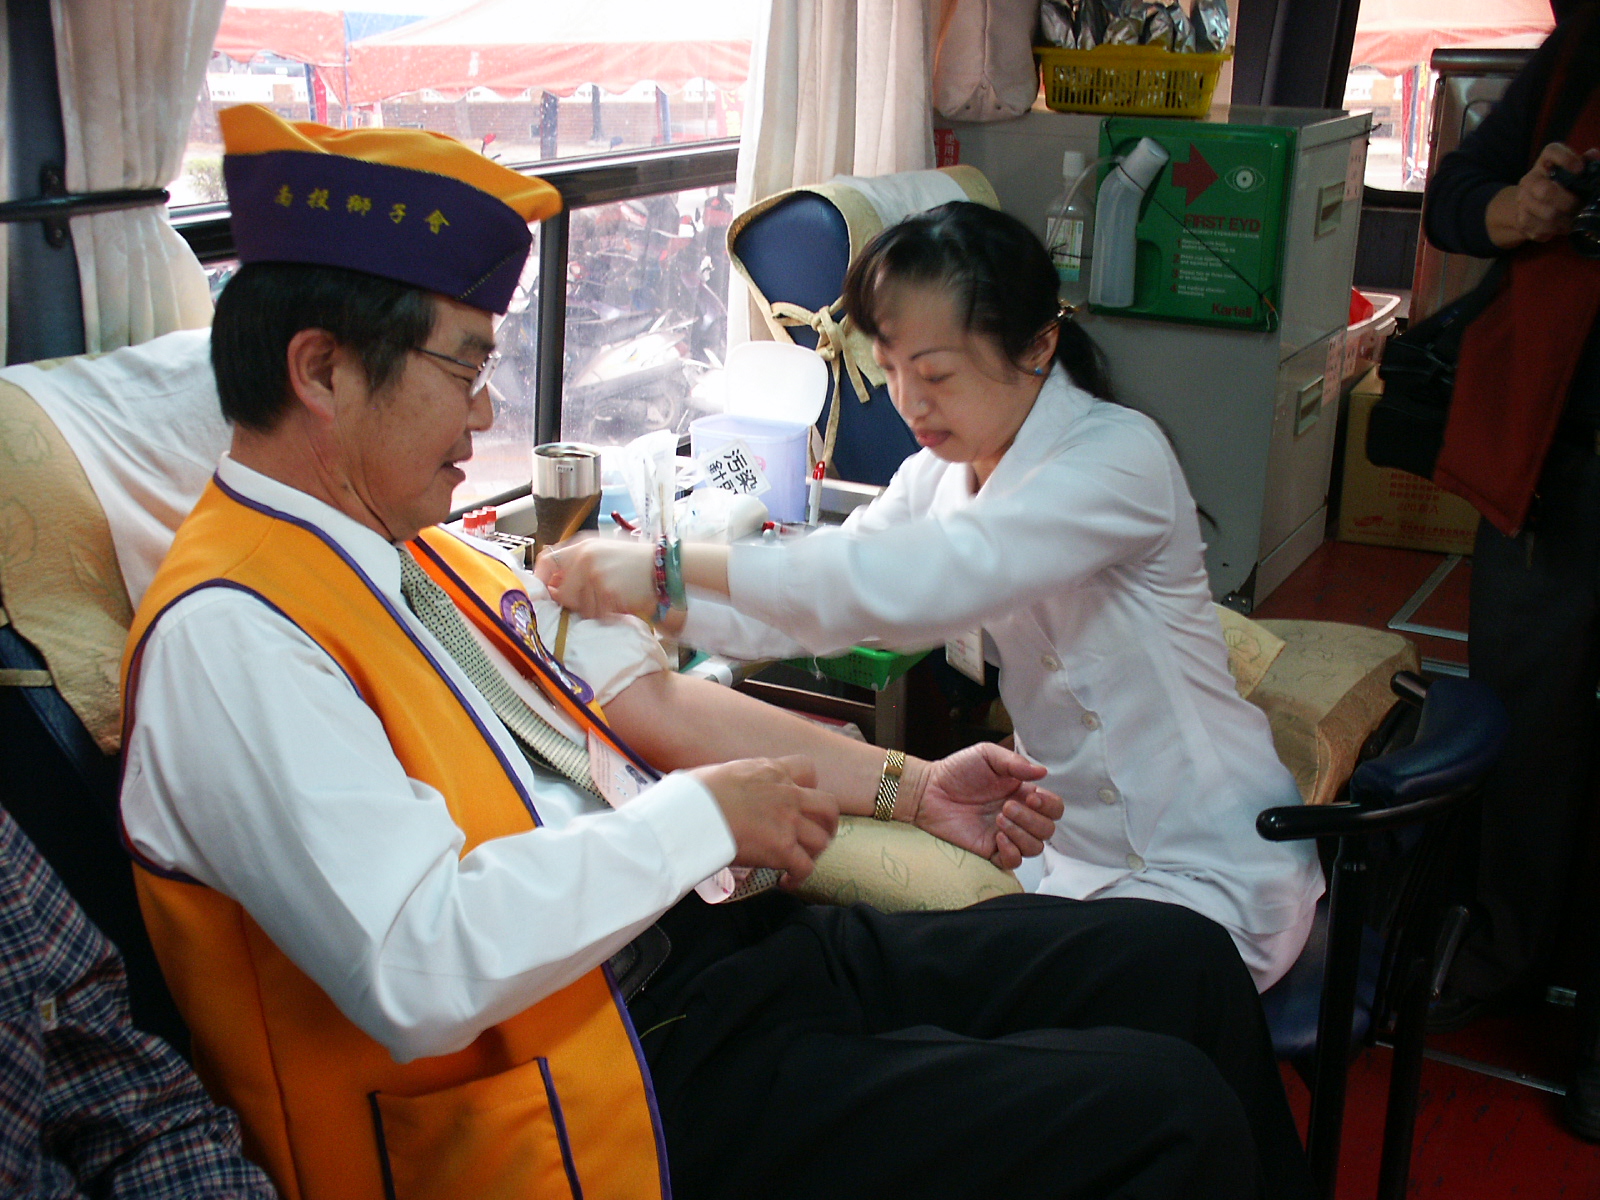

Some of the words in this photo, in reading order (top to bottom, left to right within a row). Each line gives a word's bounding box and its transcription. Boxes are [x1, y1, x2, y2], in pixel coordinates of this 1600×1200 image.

[1184, 214, 1226, 229] FIRST
[1229, 218, 1261, 232] EYD
[723, 448, 758, 494] 污染
